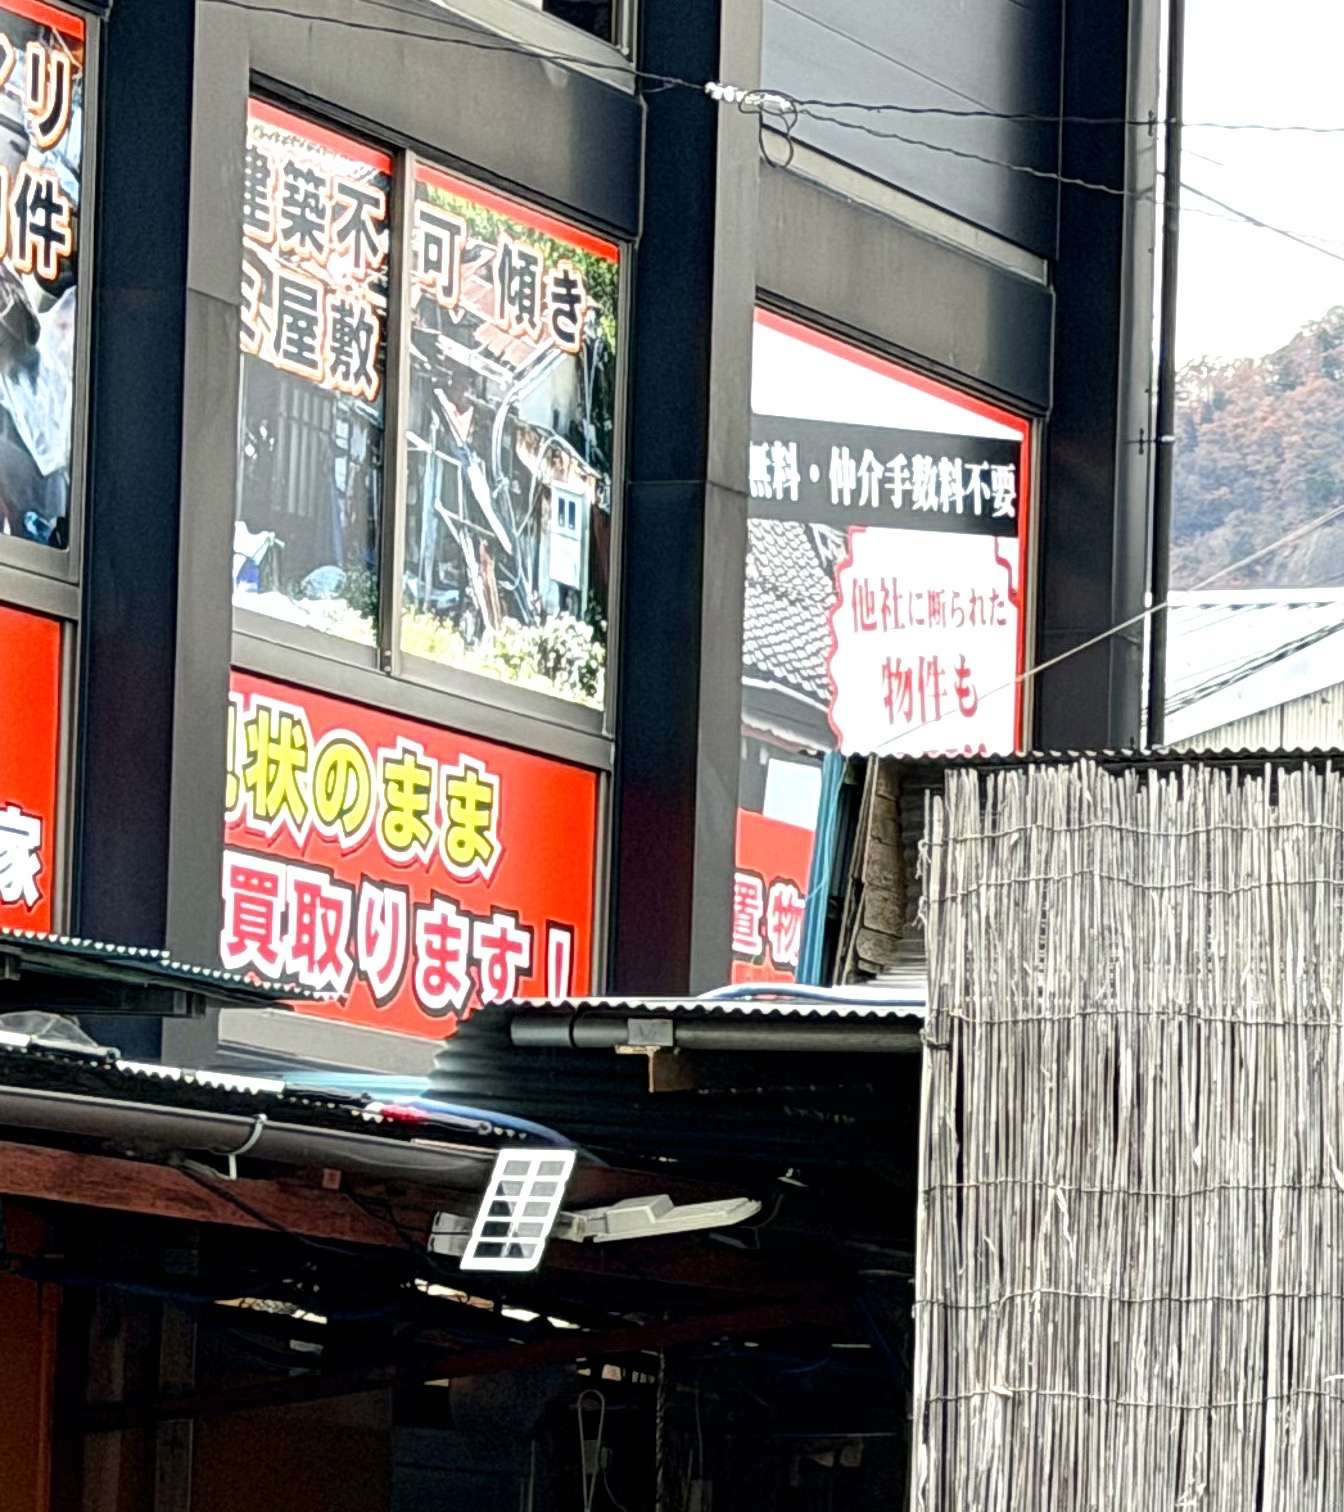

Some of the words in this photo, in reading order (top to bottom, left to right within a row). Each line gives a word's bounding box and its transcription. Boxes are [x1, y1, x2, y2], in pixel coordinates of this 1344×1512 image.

[851, 576, 1007, 633] 他社に断られた
[881, 653, 979, 725] 物件も
[225, 700, 499, 874] 状のまま
